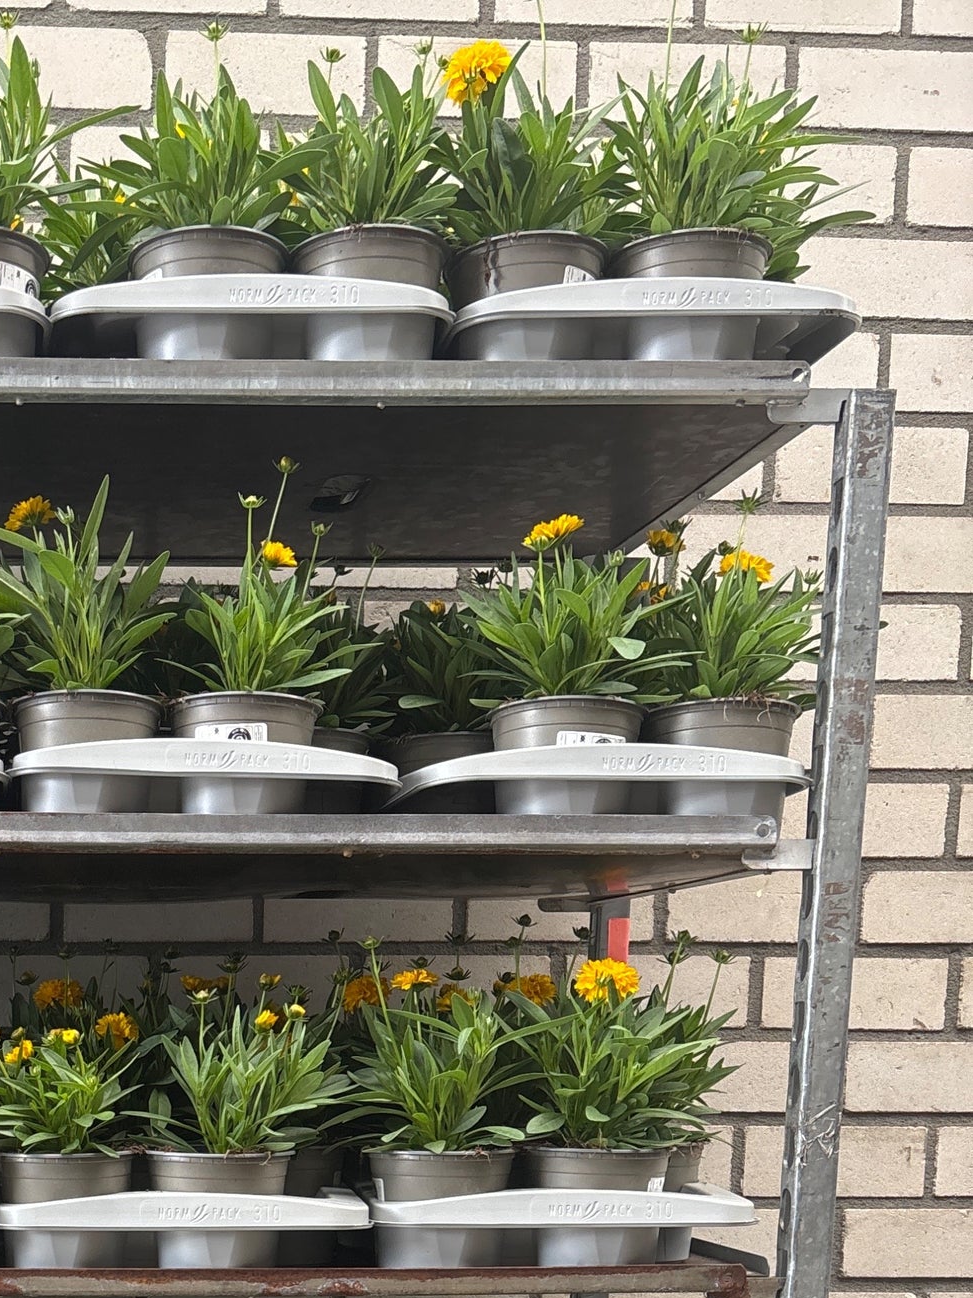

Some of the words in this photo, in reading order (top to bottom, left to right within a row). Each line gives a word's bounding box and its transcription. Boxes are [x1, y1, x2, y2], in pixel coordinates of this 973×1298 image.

[230, 288, 263, 303] NORM
[330, 286, 359, 304] 310
[643, 291, 677, 305] NORM
[185, 753, 216, 767] NORM
[283, 753, 310, 770] 310
[602, 757, 635, 771] NORM
[699, 756, 727, 773] 310
[158, 1207, 190, 1220] NORM
[254, 1205, 282, 1223] 310
[549, 1204, 581, 1218] NORM
[646, 1202, 673, 1219] 310
